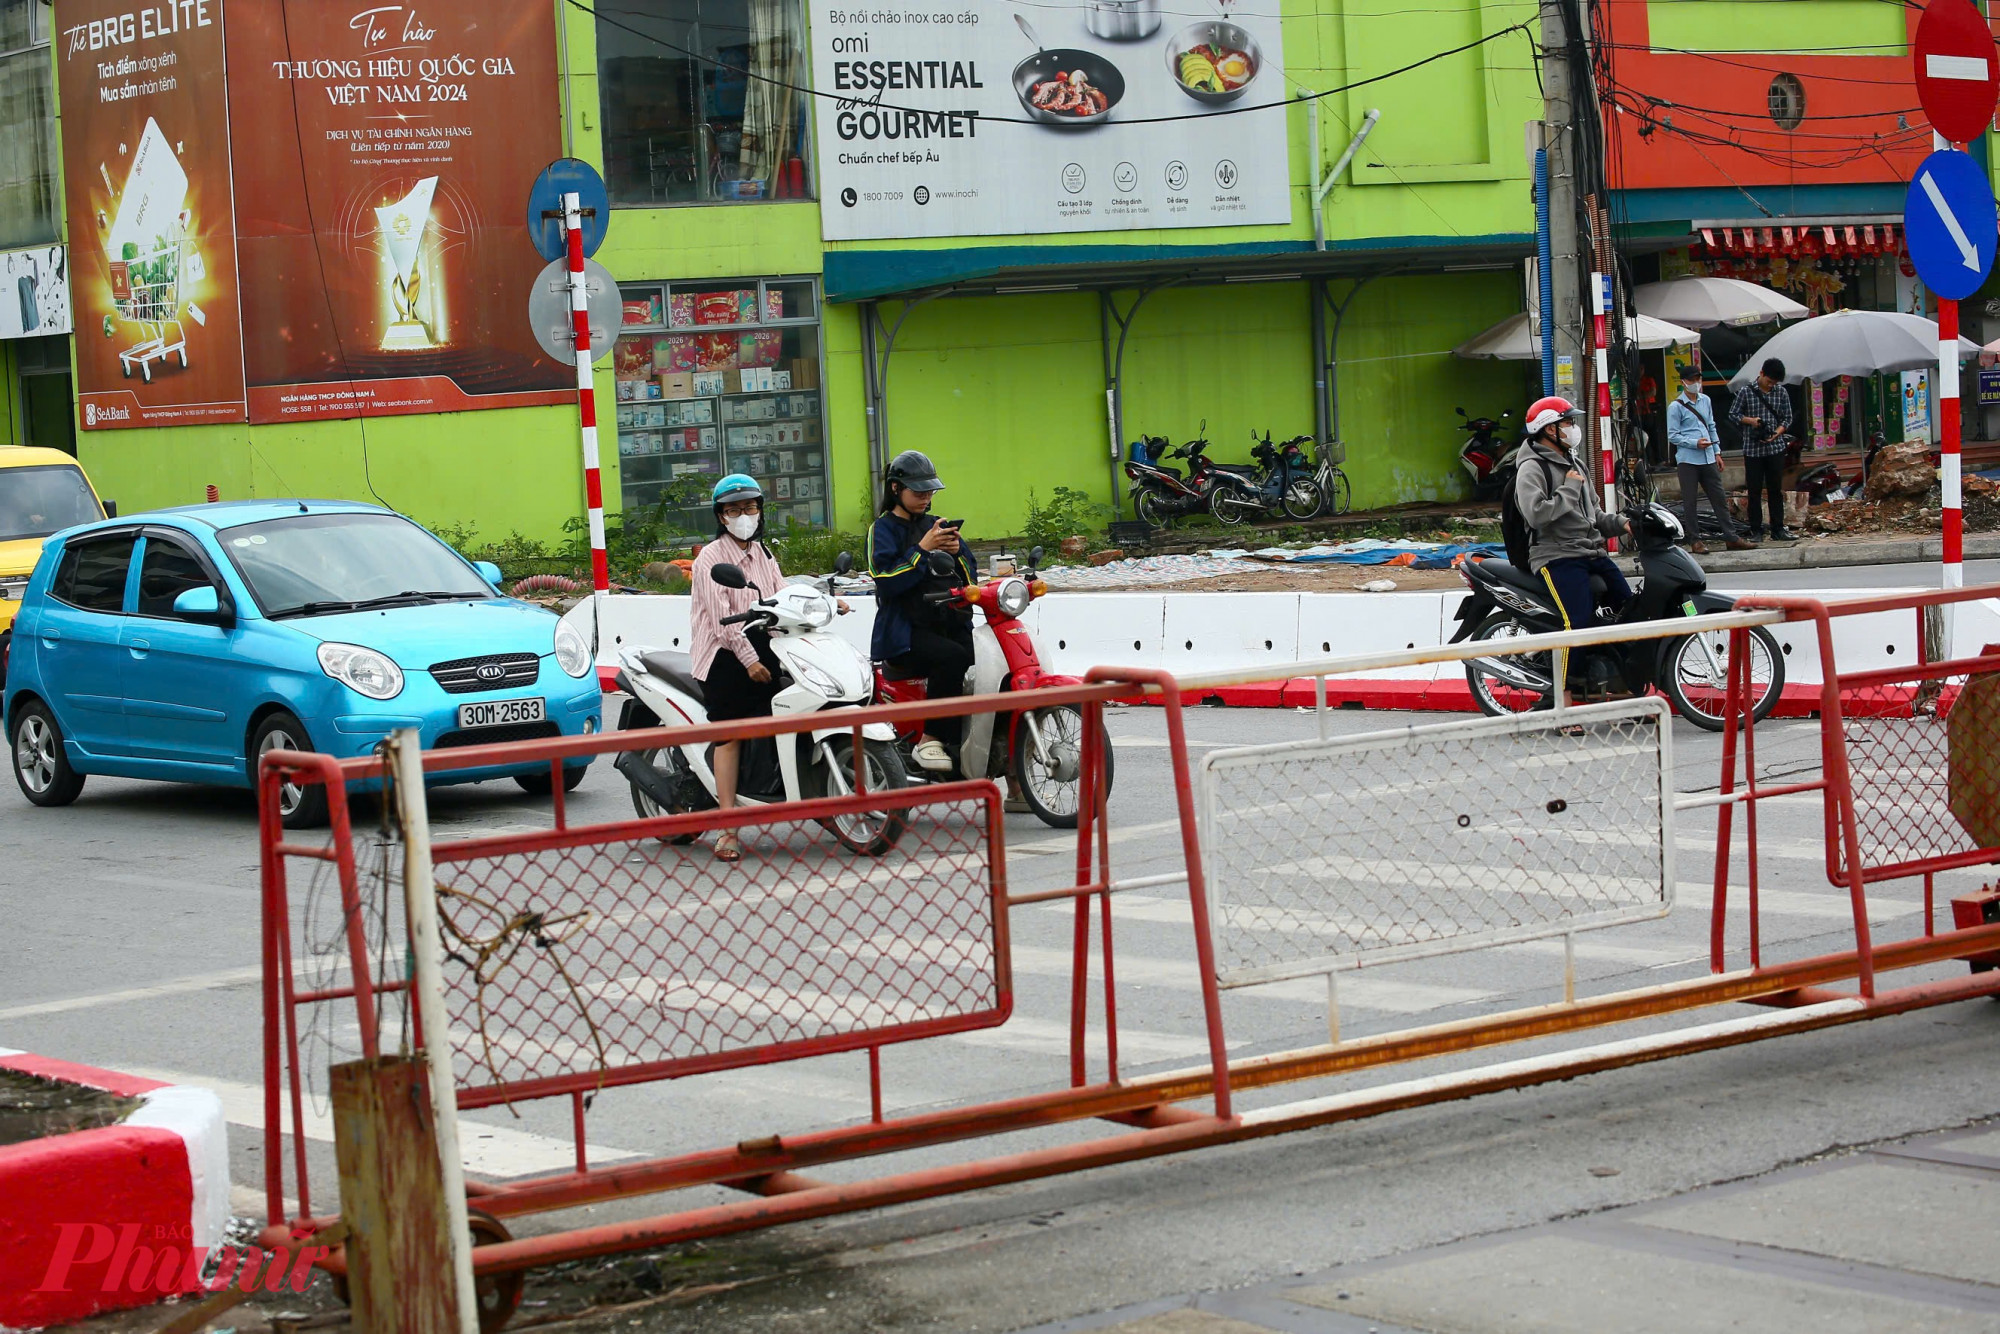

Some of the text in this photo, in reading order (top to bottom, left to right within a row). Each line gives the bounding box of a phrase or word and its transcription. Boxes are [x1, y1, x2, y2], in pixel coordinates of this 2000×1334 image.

[88, 13, 136, 50] BRG
[141, 0, 212, 40] ELITE
[350, 6, 436, 48] Tự hào
[830, 9, 978, 26] Bộ nồi chảo inox cao cấp
[832, 32, 868, 53] omi
[98, 51, 176, 80] Tích điểm xông xênh
[272, 53, 516, 83] THƯƠNG HIỆU QUỐC GIA
[834, 61, 984, 90] ESSENTIAL
[100, 87, 119, 104] Mua
[120, 78, 138, 100] sắm
[326, 83, 468, 108] VIỆT NAM 2024
[836, 76, 888, 116] and
[351, 129, 364, 140] VỤ
[367, 127, 382, 139] TÀI
[384, 126, 412, 138] CHÍNH
[416, 126, 442, 138] NGÂN
[445, 125, 472, 136] HÀNG
[836, 110, 980, 140] GOURMET
[374, 140, 390, 152] tiếp
[427, 140, 450, 150] 2020)
[838, 148, 940, 165] Chuẩn chef bếp Âu
[863, 192, 904, 201] 1800 7009
[934, 189, 979, 198] www.inochi
[136, 193, 149, 226] BRG
[300, 393, 317, 401] HÀNG
[96, 405, 130, 421] SeABank
[481, 668, 501, 677] KIA
